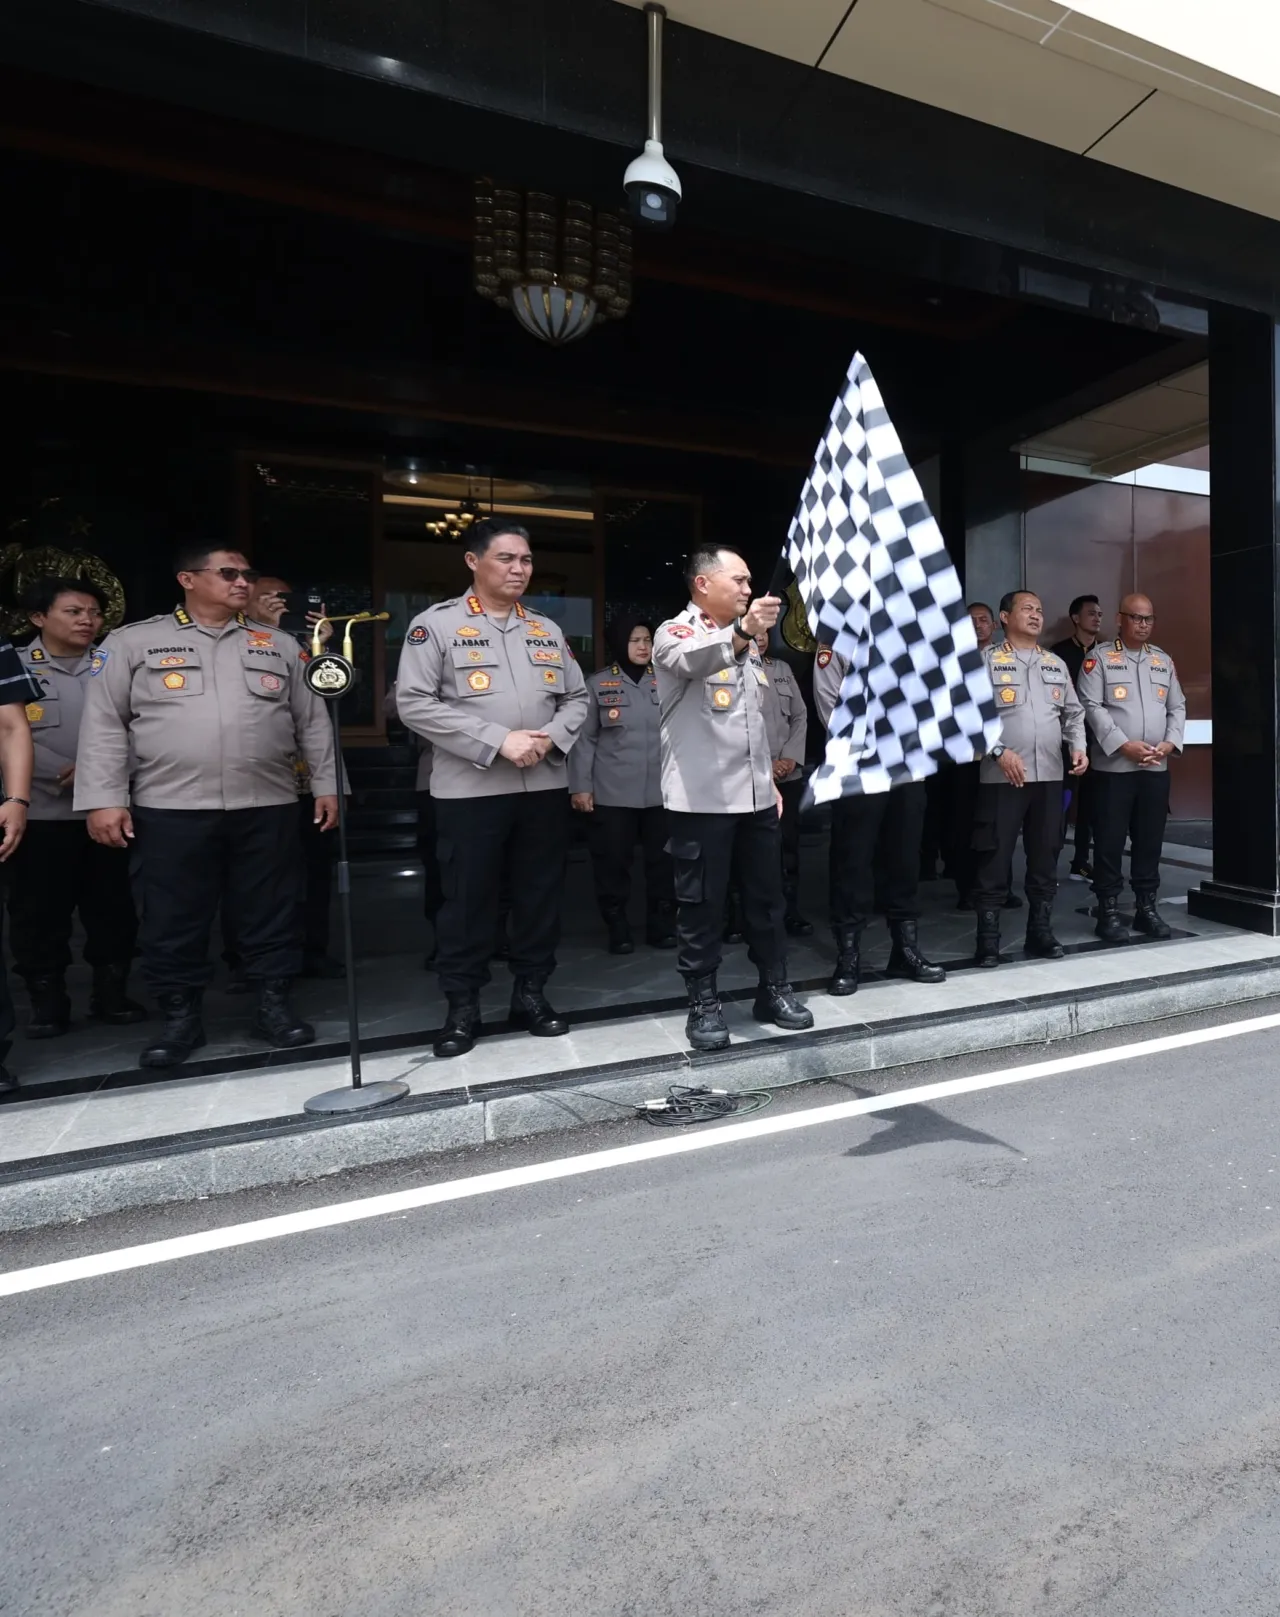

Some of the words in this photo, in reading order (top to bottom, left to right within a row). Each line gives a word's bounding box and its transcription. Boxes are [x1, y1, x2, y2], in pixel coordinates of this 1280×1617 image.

[525, 639, 558, 648] POLRI
[147, 646, 187, 656] SINGGIH
[248, 649, 282, 658] POLRI
